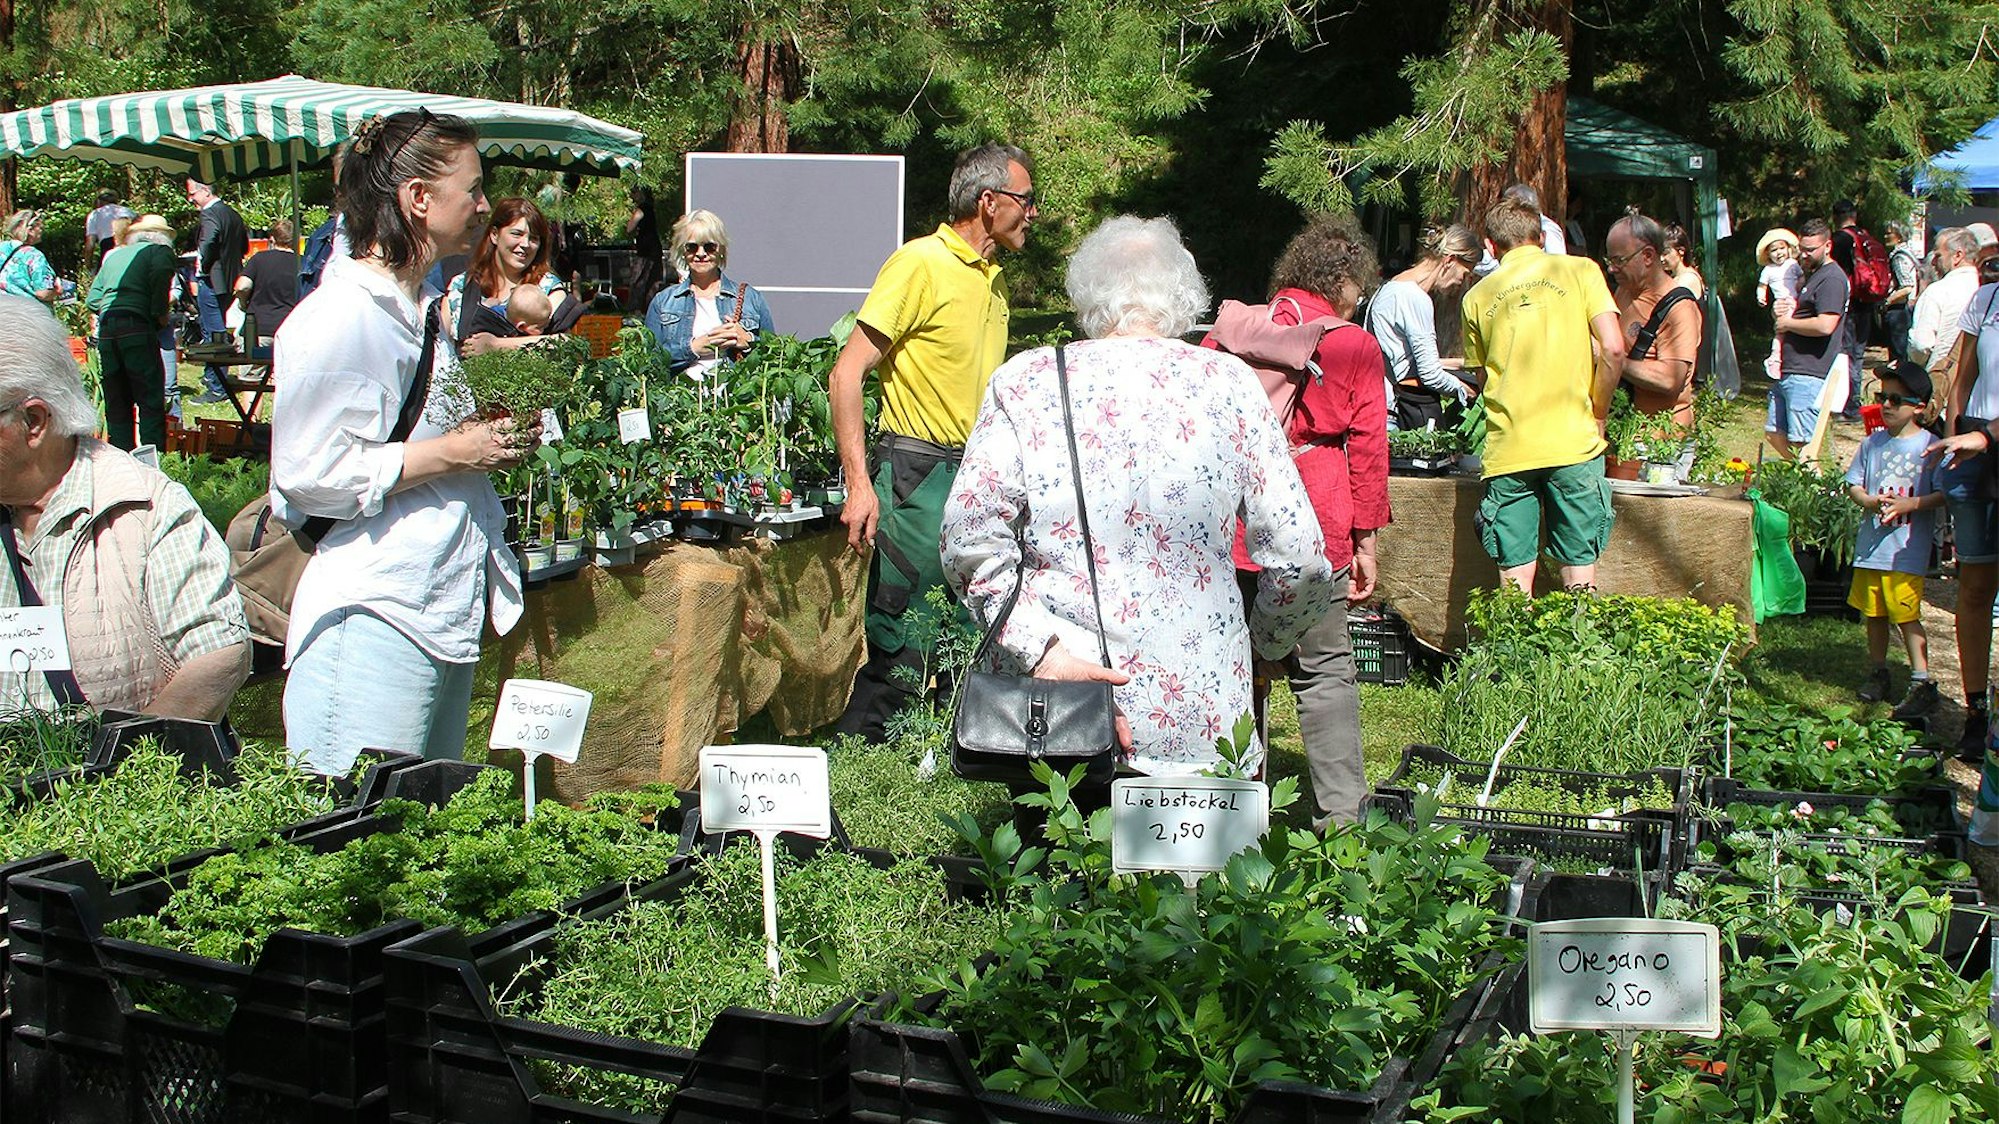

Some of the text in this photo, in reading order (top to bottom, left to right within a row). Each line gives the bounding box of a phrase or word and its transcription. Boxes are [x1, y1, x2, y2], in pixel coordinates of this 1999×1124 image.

[1486, 303, 1498, 318] Die
[29, 647, 55, 662] 2,50
[511, 694, 573, 718] Petersilie
[517, 723, 550, 741] 2,50
[713, 764, 801, 791] Thymian
[738, 794, 775, 817] 2,50
[1149, 822, 1205, 844] 2,50
[1558, 945, 1670, 975] Oregano
[1595, 982, 1652, 1012] 2,50
